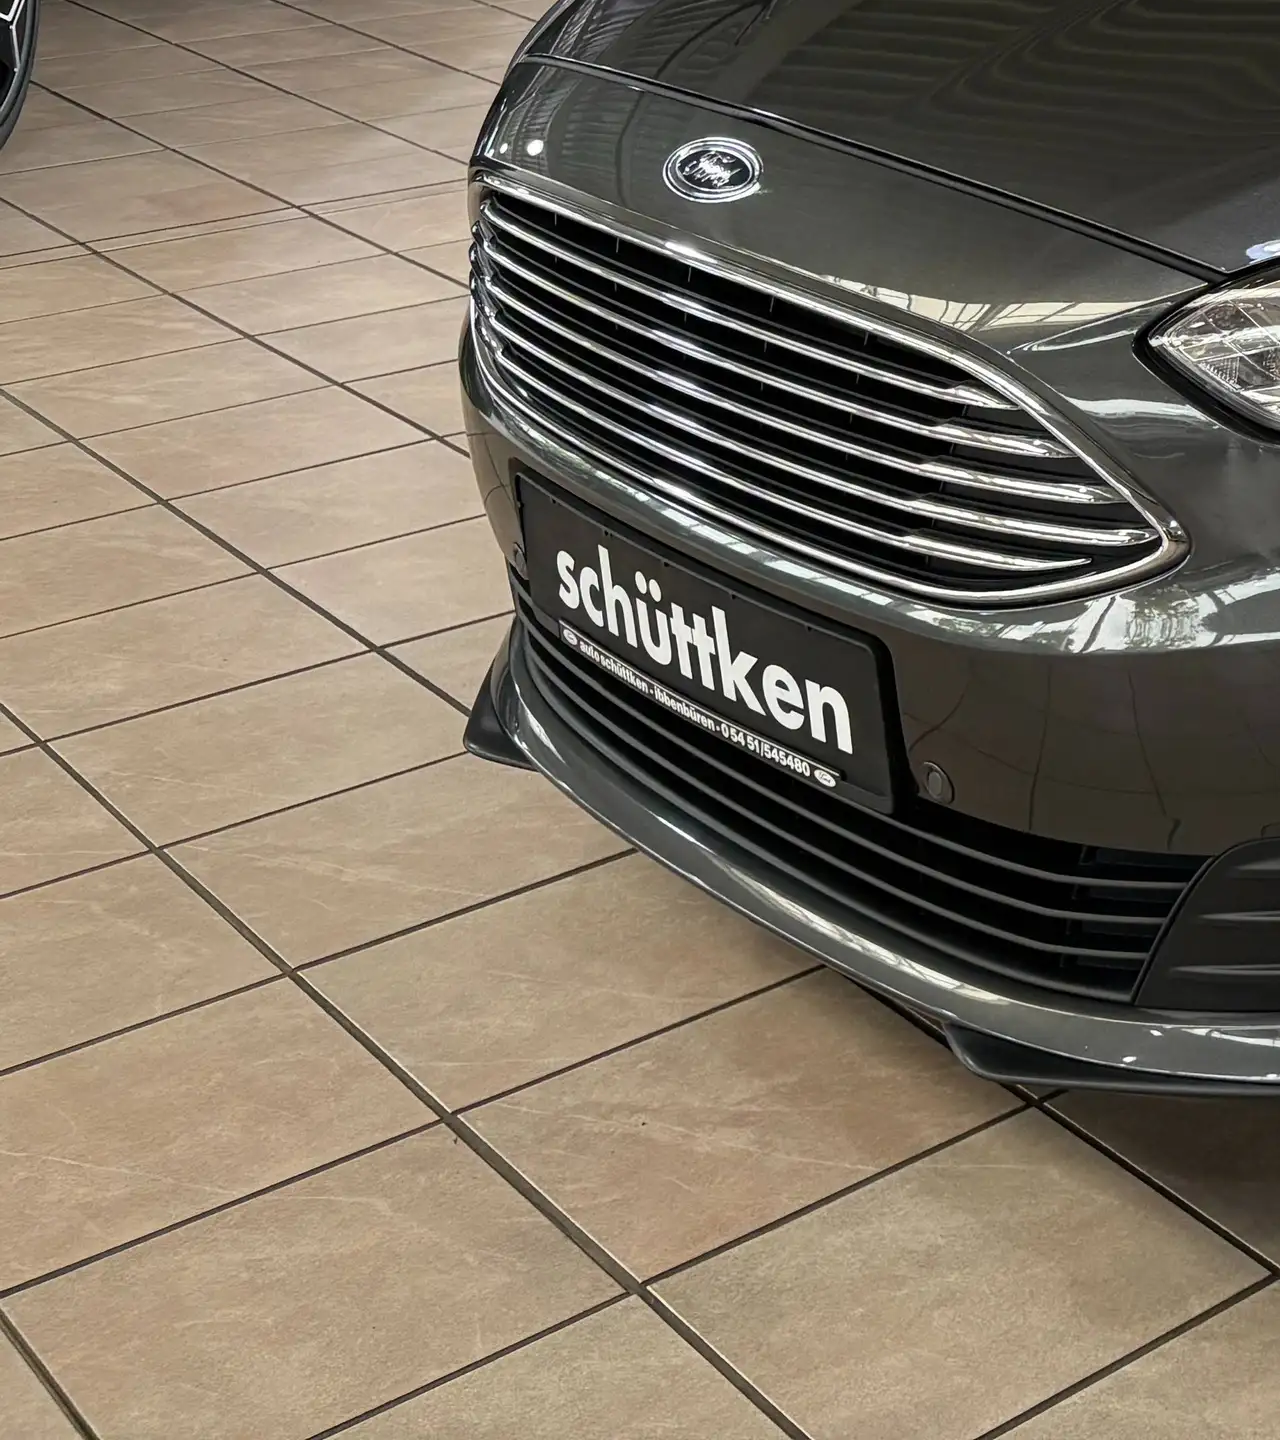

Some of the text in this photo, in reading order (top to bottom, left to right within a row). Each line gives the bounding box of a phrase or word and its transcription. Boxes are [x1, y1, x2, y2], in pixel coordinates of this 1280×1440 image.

[556, 544, 853, 754] schüttken
[579, 640, 600, 662] auto
[600, 655, 649, 694] schüttken
[654, 686, 716, 732] ibbenbüren
